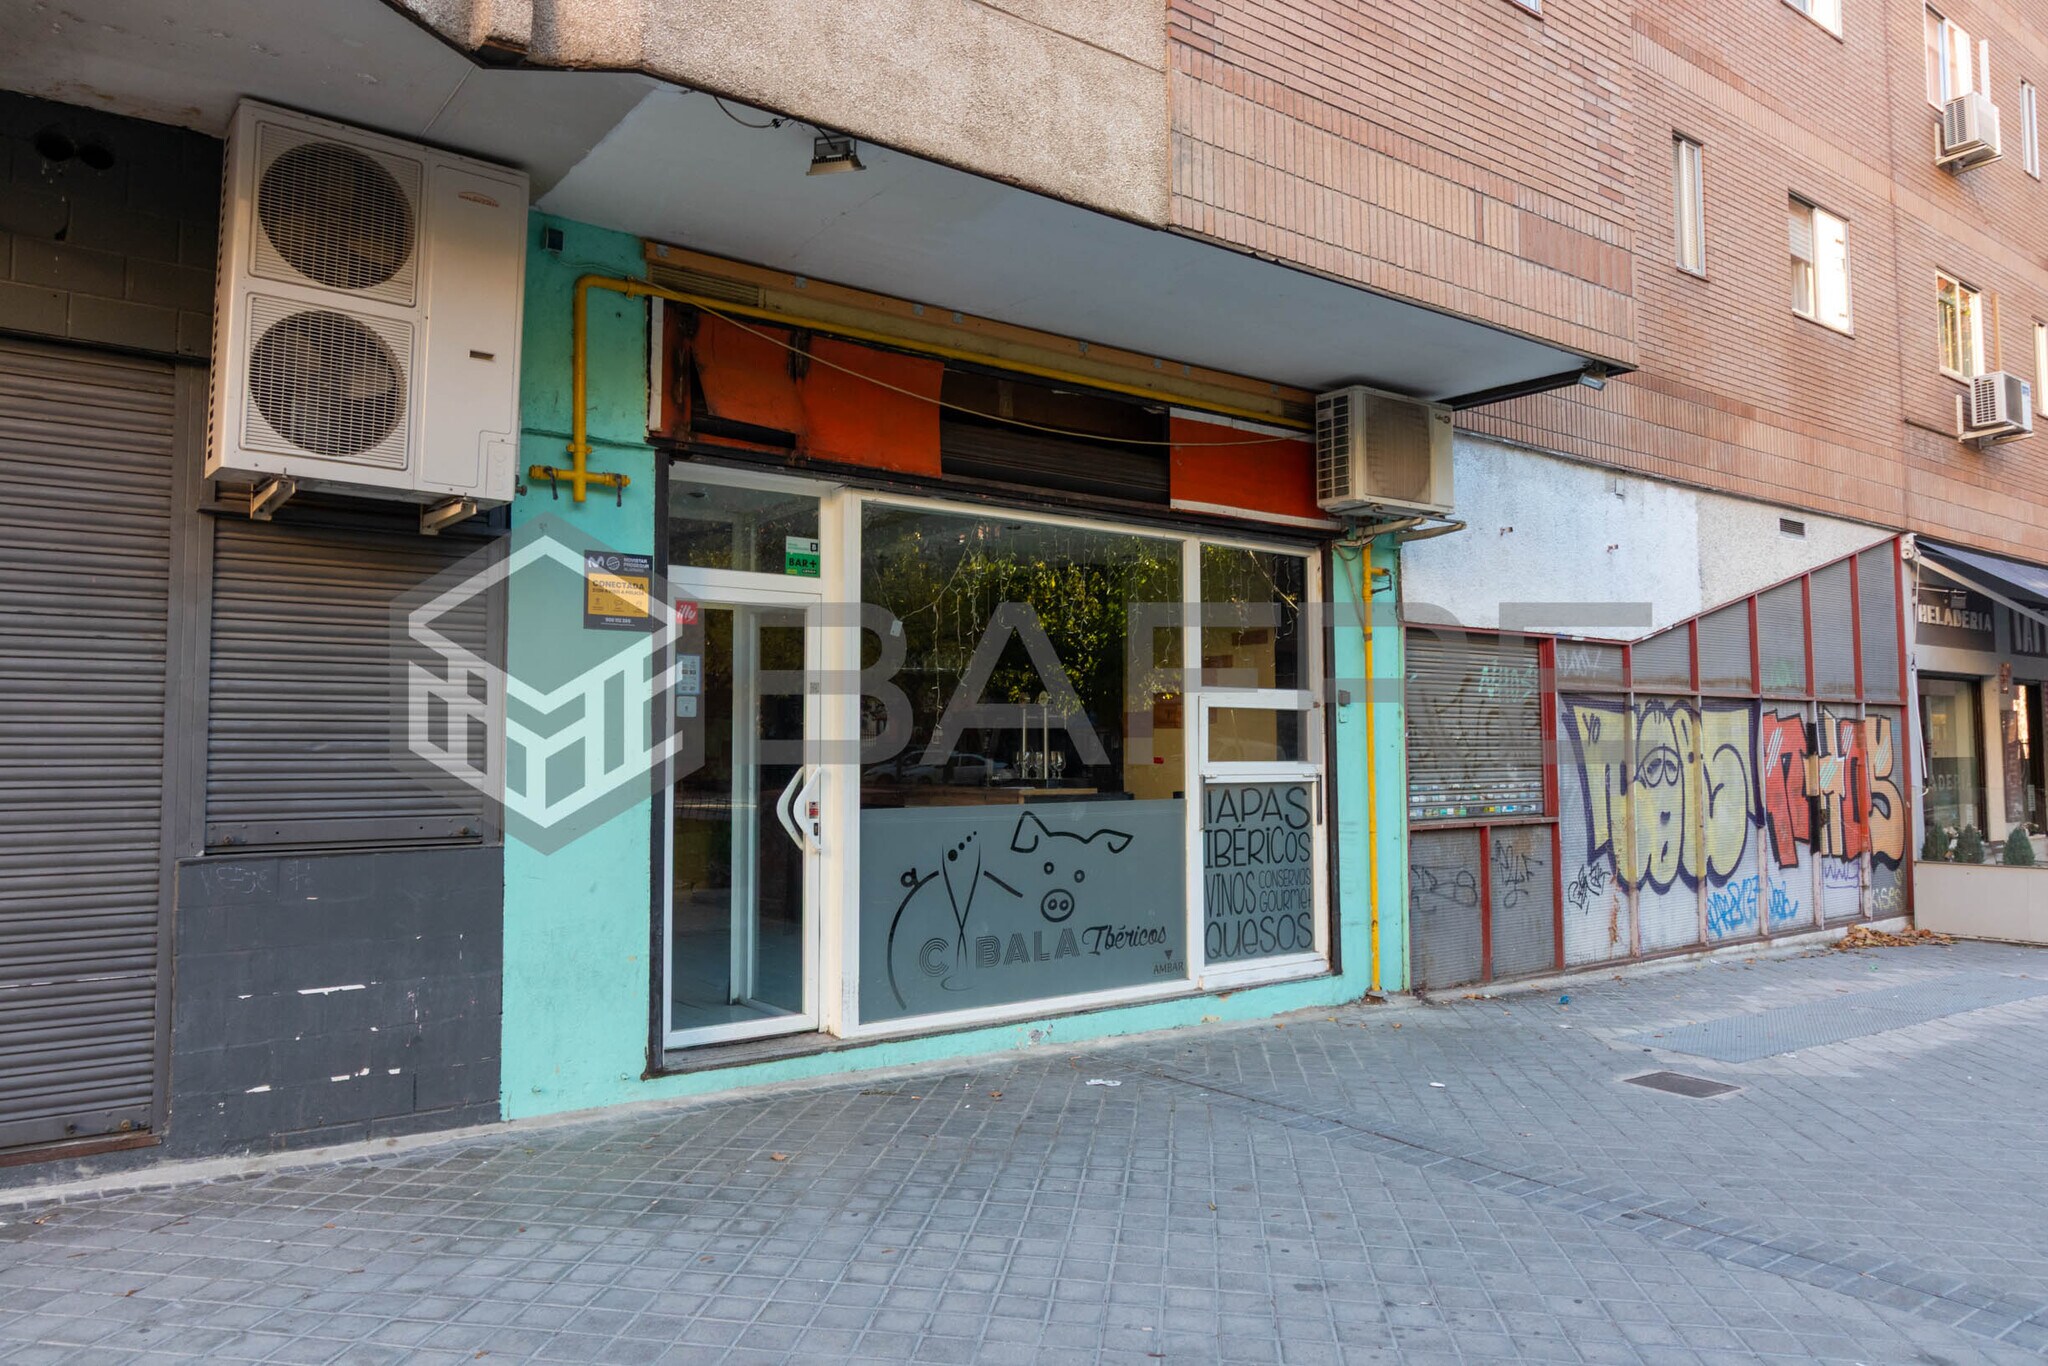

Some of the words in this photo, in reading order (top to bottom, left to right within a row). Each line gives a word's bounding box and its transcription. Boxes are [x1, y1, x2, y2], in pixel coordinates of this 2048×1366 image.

[592, 579, 645, 591] CONECTADA
[678, 603, 697, 622] illy
[1917, 603, 1993, 633] HELADERIA
[1581, 711, 1602, 746] YO
[1203, 786, 1312, 830] TAPAS
[1204, 870, 1257, 919] VINOS
[1153, 961, 1185, 975] AMBAR
